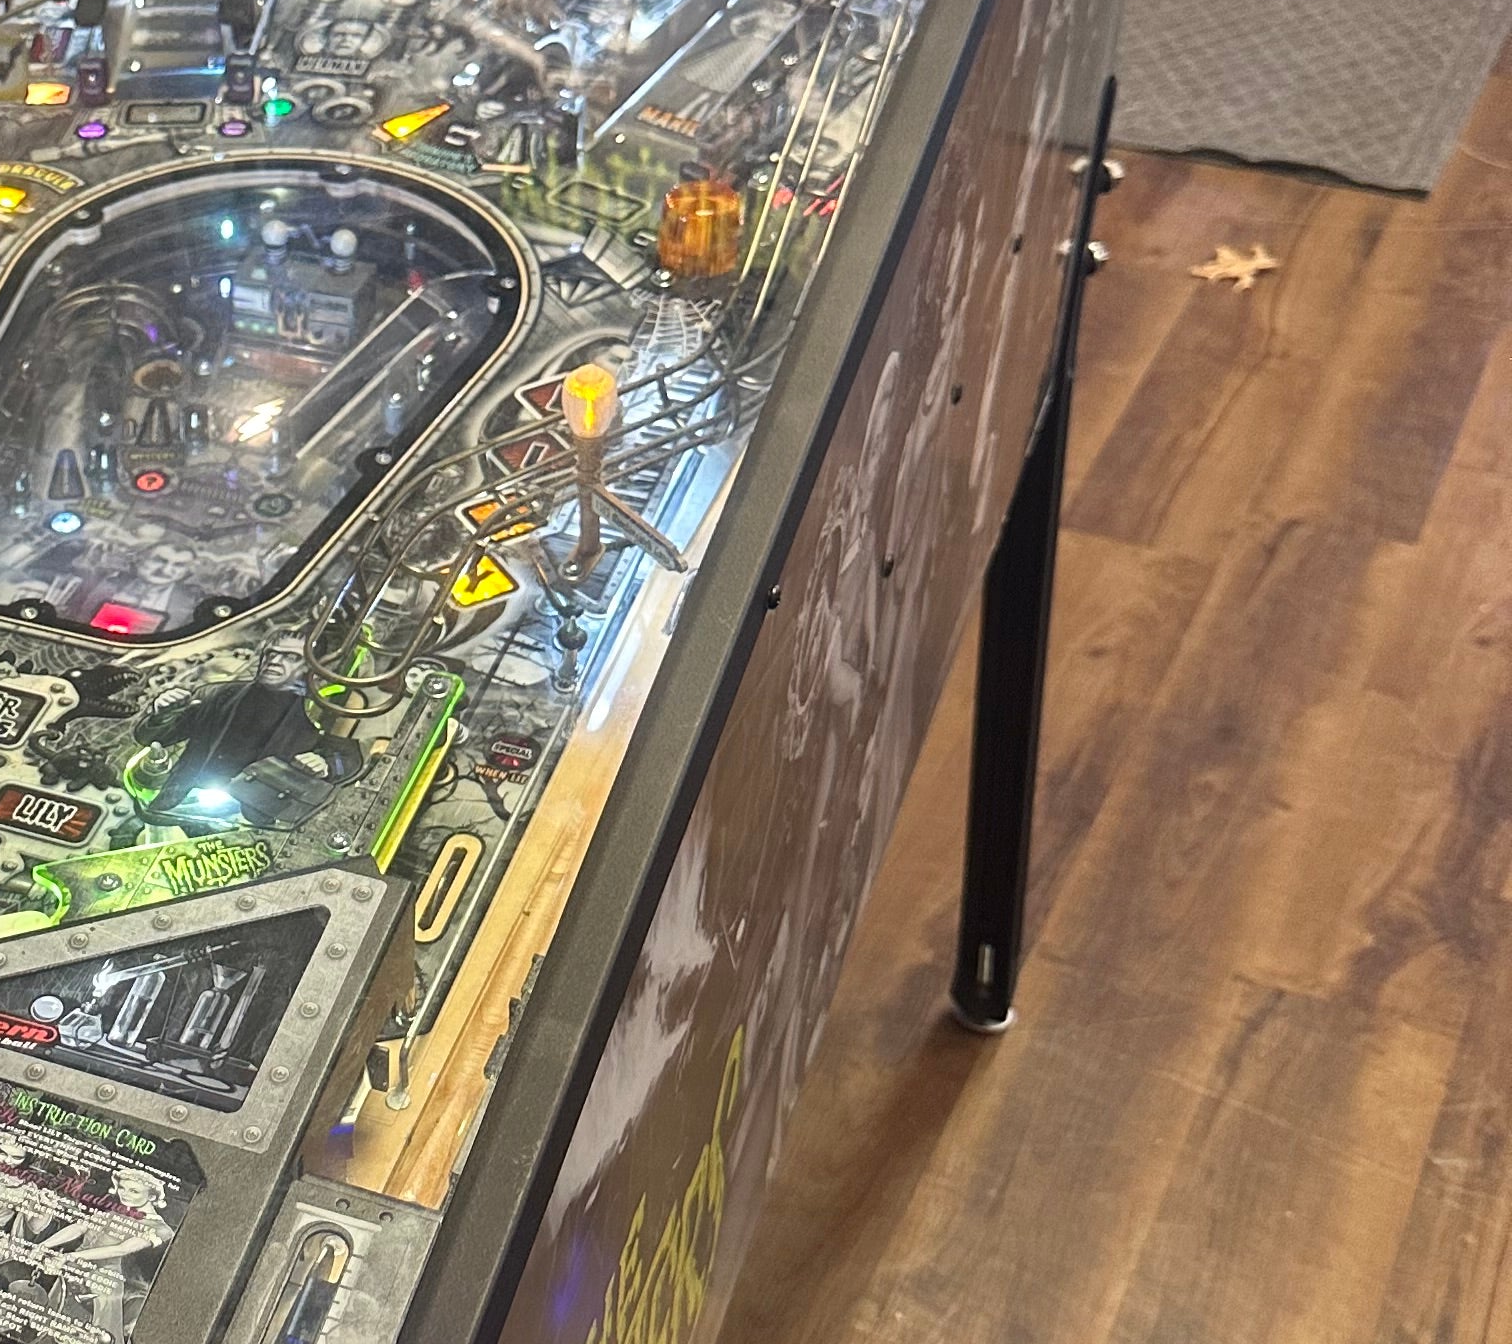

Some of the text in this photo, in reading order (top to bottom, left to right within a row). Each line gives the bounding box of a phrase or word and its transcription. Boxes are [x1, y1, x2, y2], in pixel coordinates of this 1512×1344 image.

[475, 765, 508, 780] WHEN
[12, 794, 78, 834] LILY
[198, 840, 225, 853] THE
[162, 842, 271, 895] MUNSTERS
[14, 1092, 112, 1140] INSTRUCTION
[114, 1127, 157, 1158] CARD
